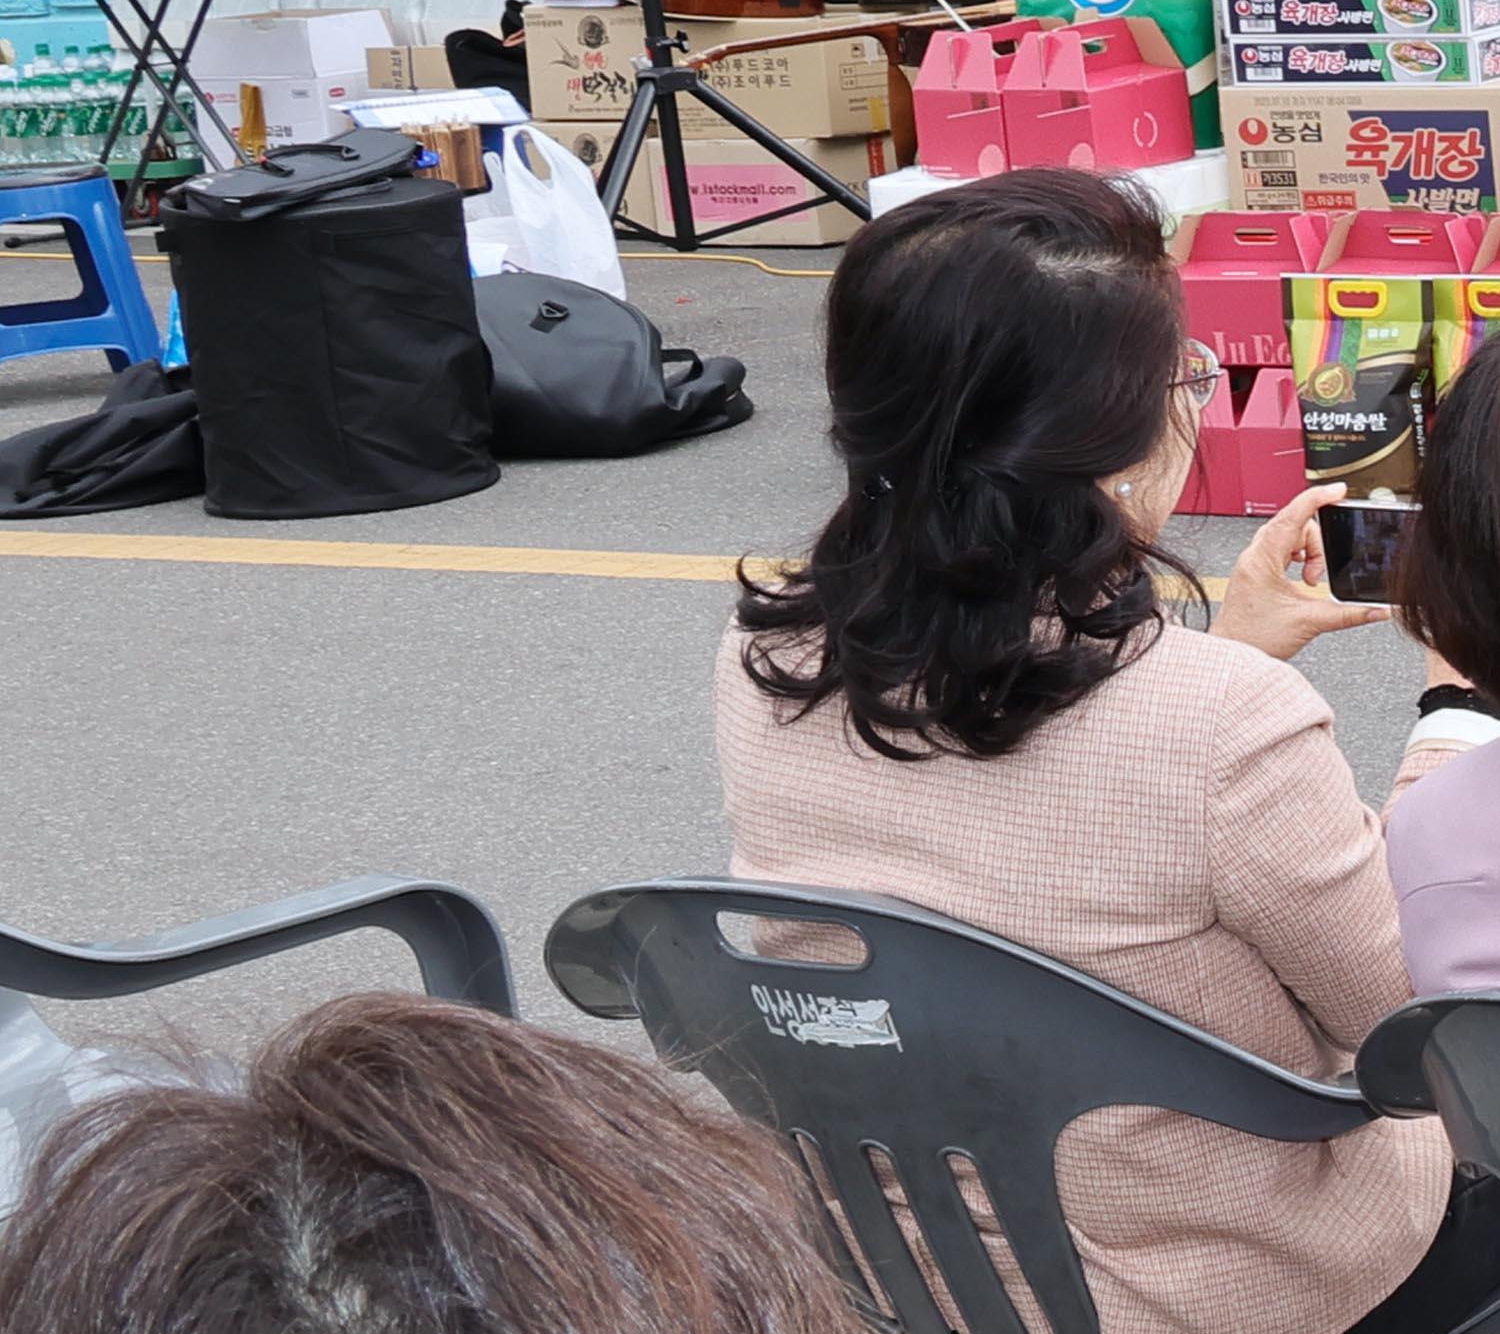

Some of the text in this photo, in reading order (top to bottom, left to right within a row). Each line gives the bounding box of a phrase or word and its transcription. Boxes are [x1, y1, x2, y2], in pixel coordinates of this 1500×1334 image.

[1288, 45, 1347, 73] 육개장
[1271, 121, 1323, 144] 농심
[1345, 118, 1484, 180] 육개장
[1318, 172, 1359, 185] 한국인의
[1406, 187, 1480, 213] 사발면
